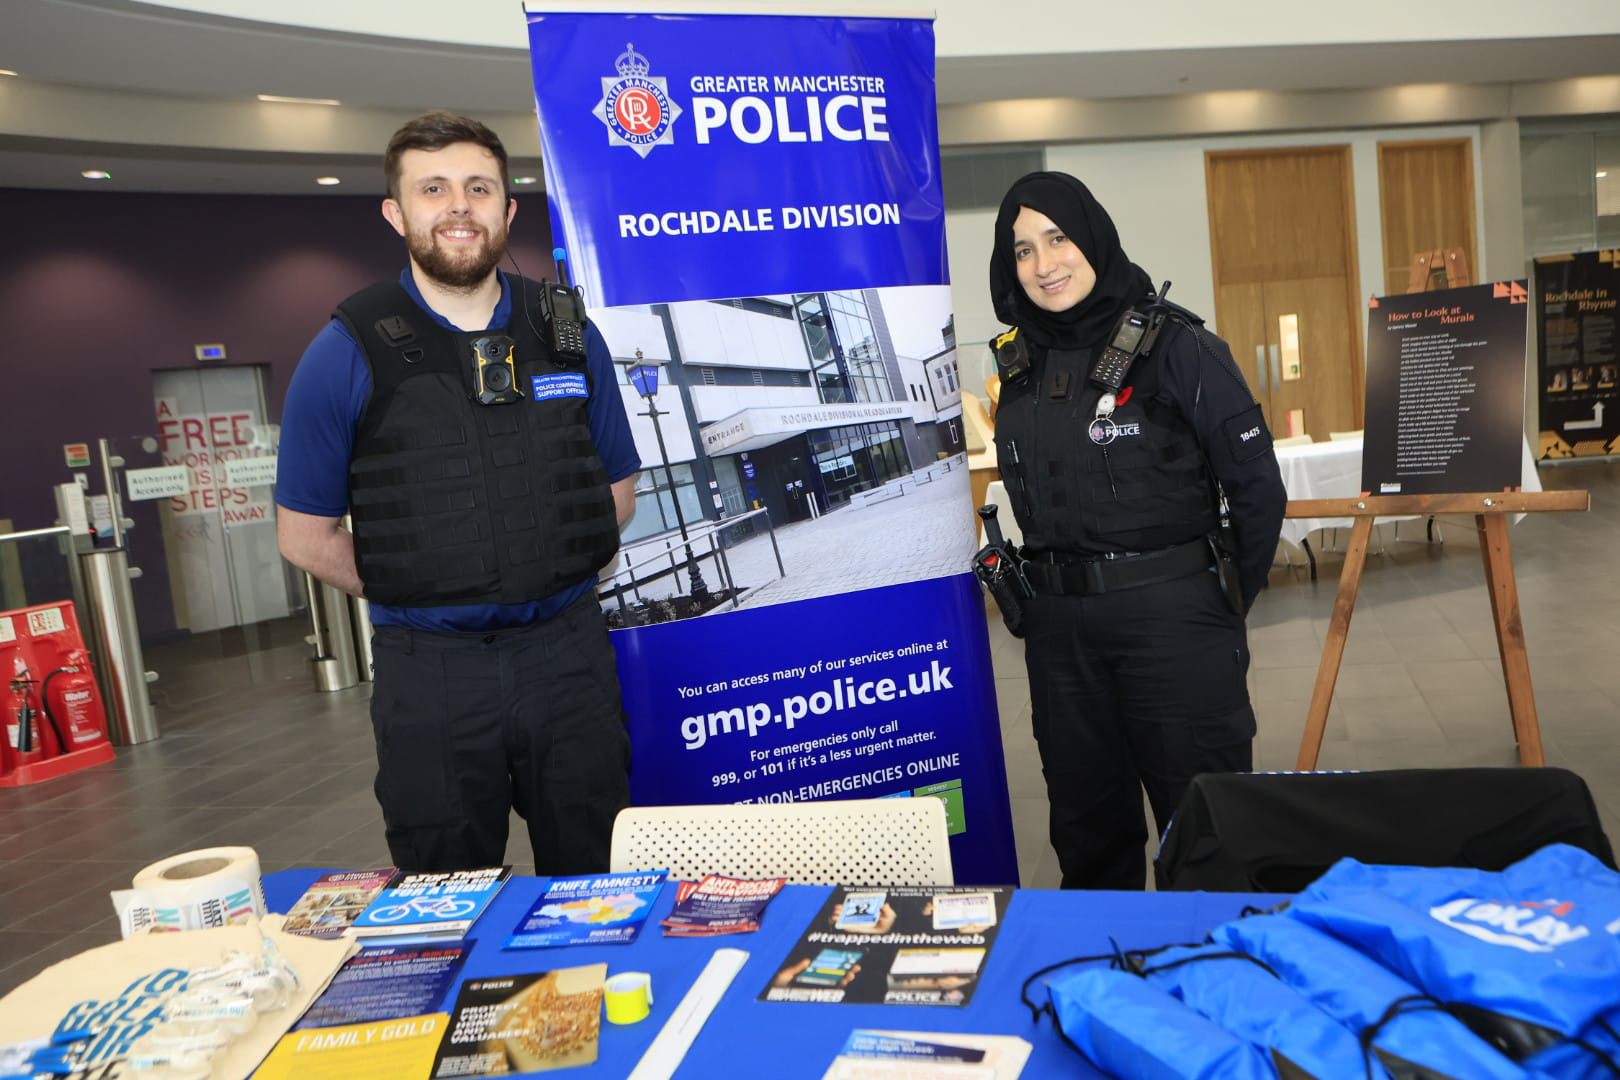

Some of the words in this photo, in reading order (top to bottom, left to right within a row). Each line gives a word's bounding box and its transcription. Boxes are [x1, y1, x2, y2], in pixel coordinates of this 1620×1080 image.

[690, 76, 769, 92] GREATER
[774, 76, 885, 93] MANCHESTER
[692, 95, 890, 144] POLICE
[624, 132, 658, 144] POLICE
[618, 208, 774, 238] ROCHDALE
[782, 203, 900, 230] DIVISION
[1388, 311, 1409, 322] How
[1412, 310, 1422, 319] to
[1424, 307, 1449, 318] Look
[1451, 306, 1461, 314] at
[1440, 313, 1475, 325] Murals
[159, 401, 172, 416] A
[160, 415, 250, 452] FREE
[708, 422, 745, 445] ENTRANCE
[1105, 427, 1140, 437] POLICE
[132, 473, 185, 485] Authorised
[233, 475, 257, 484] Access
[135, 487, 165, 496] Access
[166, 483, 185, 494] only
[171, 487, 249, 512] STEPS
[223, 507, 267, 524] AWAY
[678, 687, 702, 699] You
[706, 680, 728, 693] can
[731, 673, 769, 689] access
[772, 665, 806, 682] many
[809, 662, 823, 674] of
[825, 660, 847, 671] our
[848, 649, 894, 667] services
[897, 642, 933, 657] online
[935, 639, 948, 650] at
[680, 660, 954, 750] gmp.police.uk
[750, 750, 770, 762] For
[773, 733, 848, 758] emergencies
[851, 726, 876, 742] only
[879, 720, 899, 735] call
[711, 771, 741, 787] 999,
[743, 769, 758, 780] or
[760, 762, 784, 776] 101
[787, 759, 797, 771] if
[799, 755, 817, 769] it's
[819, 754, 828, 763] a
[830, 749, 852, 762] less
[854, 738, 894, 758] urgent
[896, 730, 937, 747] matter.
[757, 764, 903, 806] NON-EMERGENCIES
[906, 753, 960, 776] ONLINE
[550, 879, 591, 892] KNIFE
[591, 875, 661, 890] AMNESTY
[807, 931, 985, 945] #trappedintheweb
[885, 991, 941, 1002] POLICE
[297, 1027, 378, 1051] FAMILY
[381, 1018, 436, 1041] GOLD
